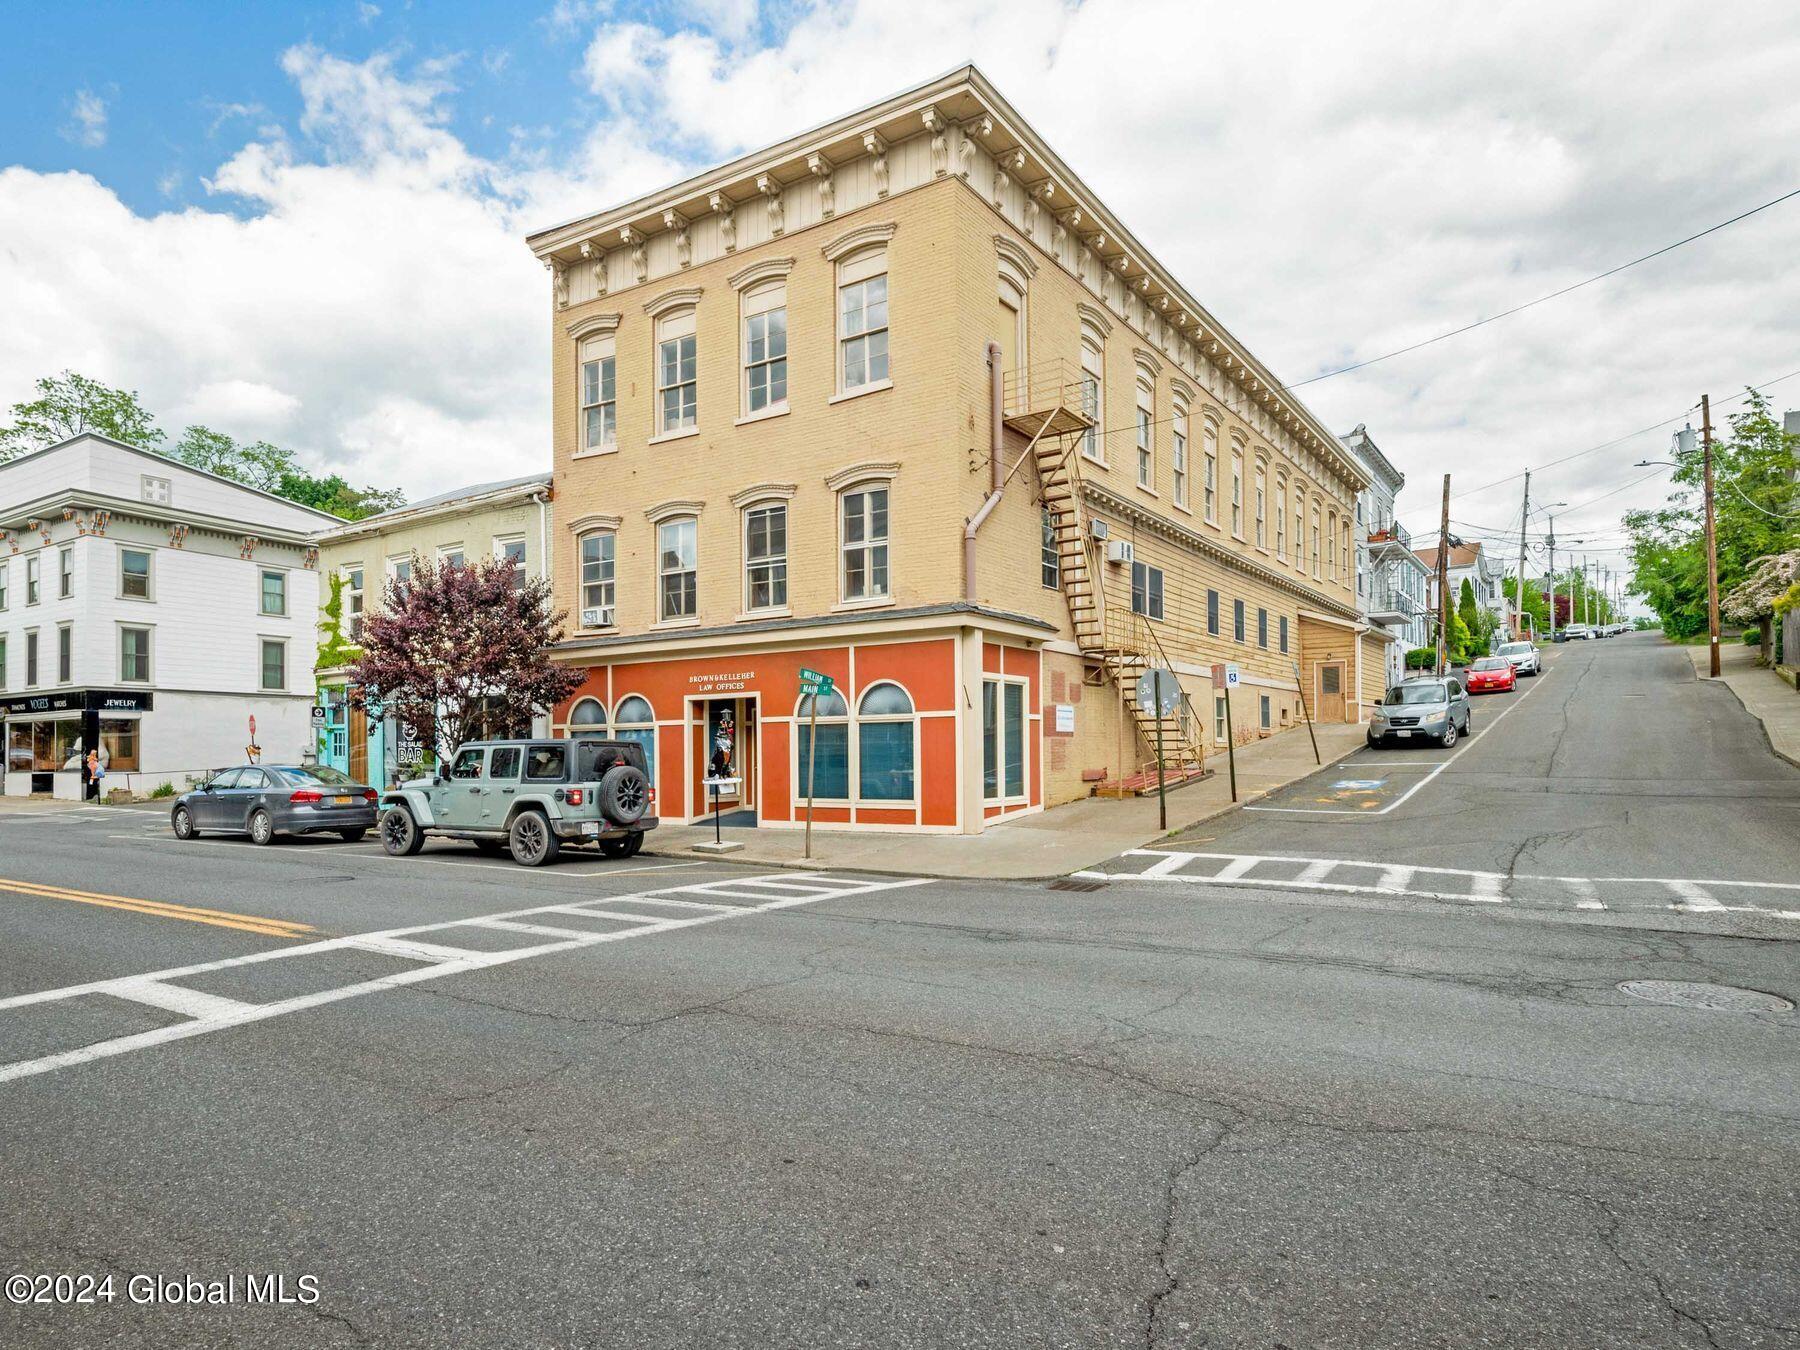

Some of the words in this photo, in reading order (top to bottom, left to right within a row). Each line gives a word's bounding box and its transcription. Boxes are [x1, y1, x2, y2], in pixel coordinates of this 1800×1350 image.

[803, 670, 823, 684] WILLIAM
[716, 682, 745, 690] OFFICES
[802, 684, 819, 693] MAIN
[104, 699, 136, 707] JEWELRY
[398, 748, 423, 763] BAR
